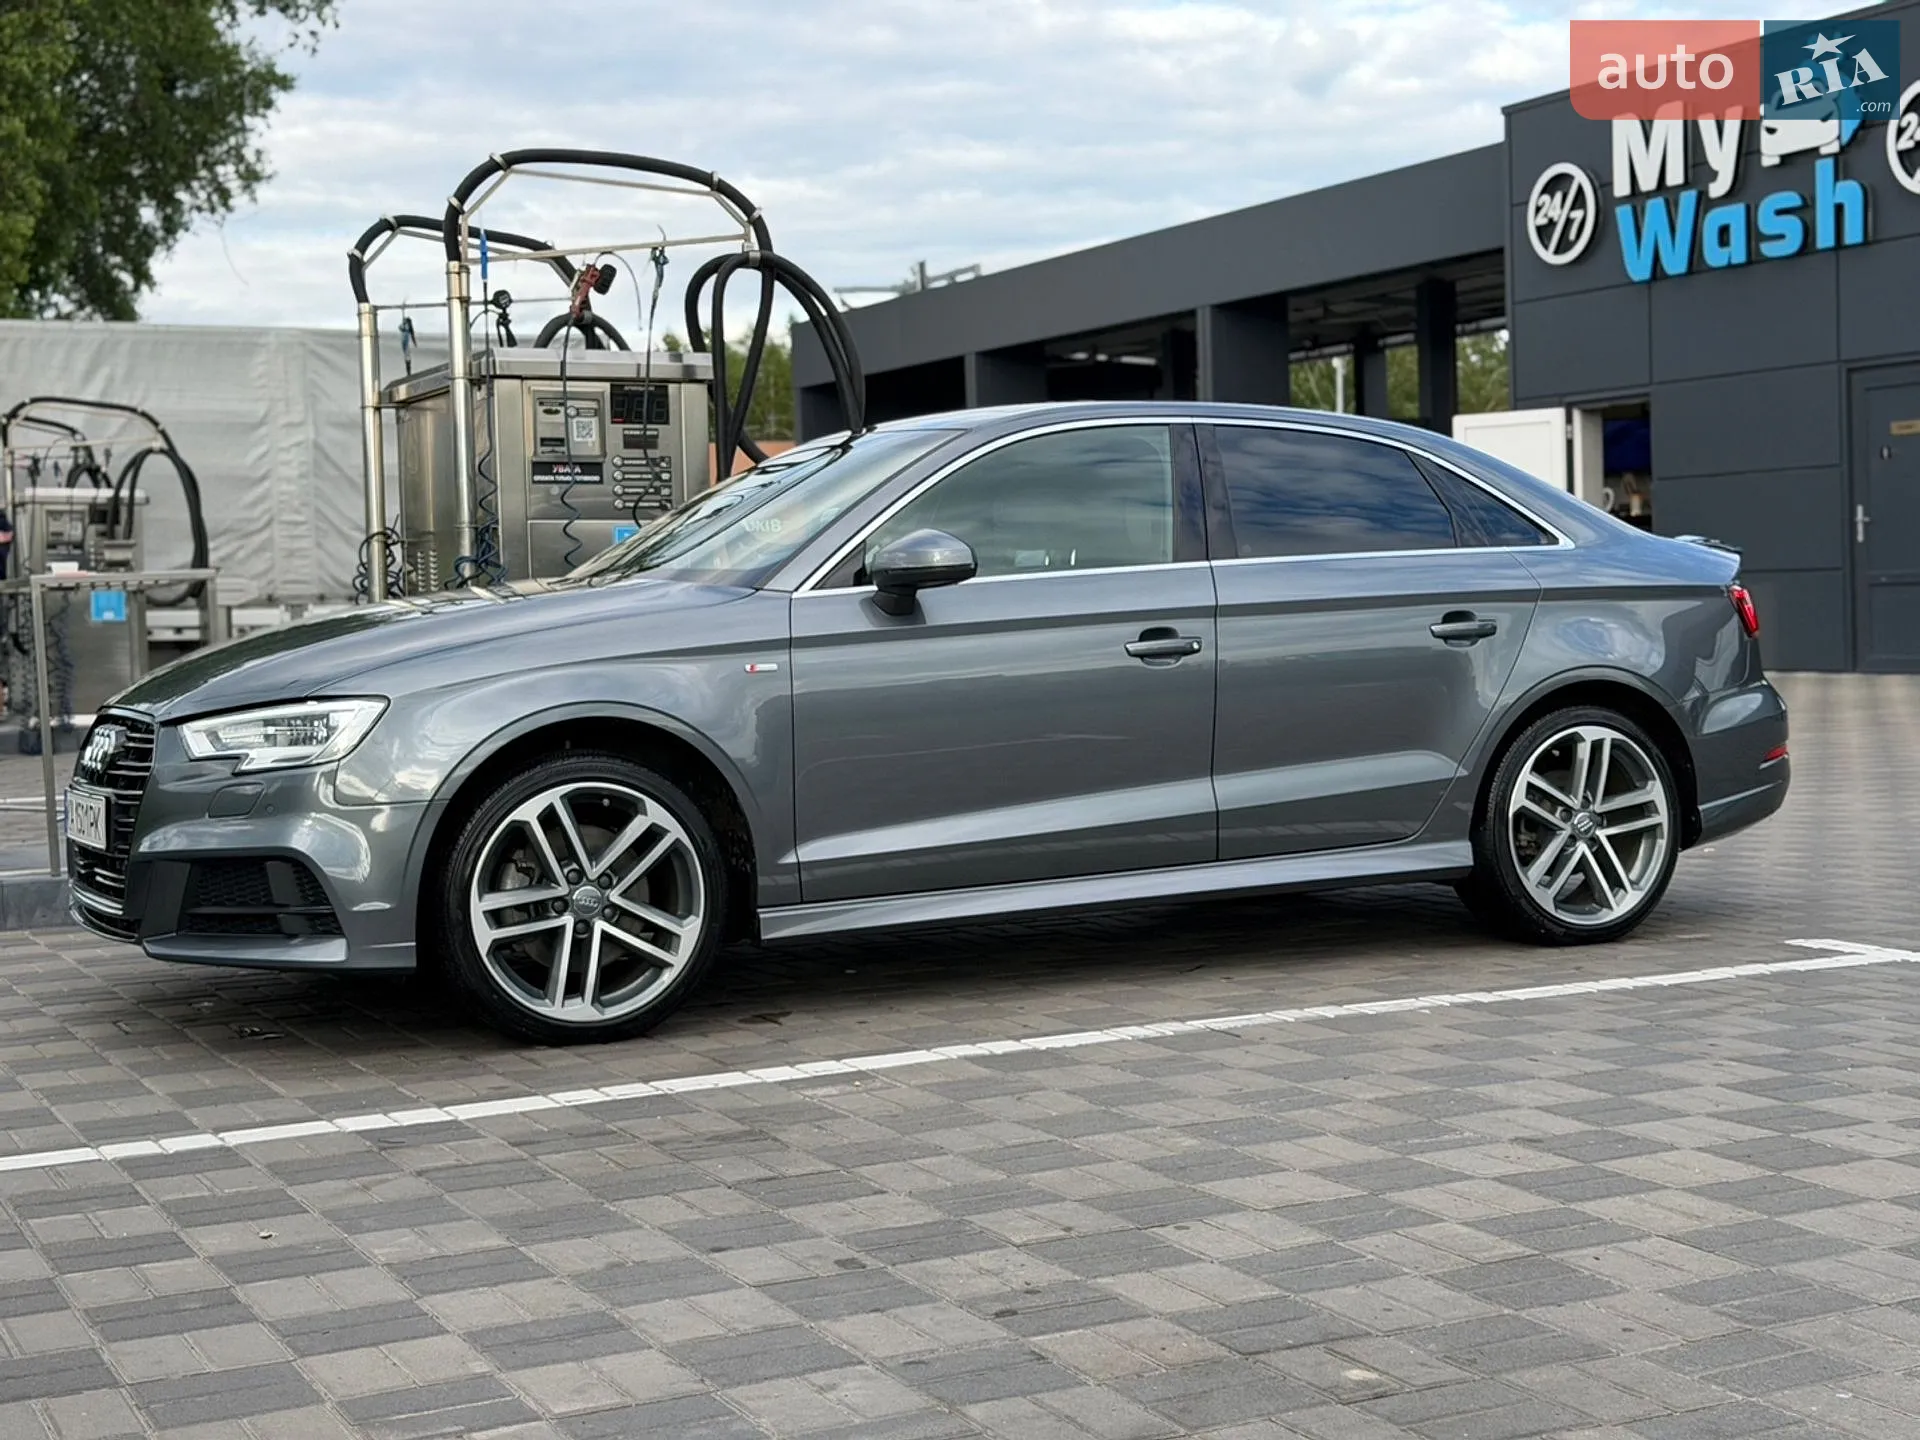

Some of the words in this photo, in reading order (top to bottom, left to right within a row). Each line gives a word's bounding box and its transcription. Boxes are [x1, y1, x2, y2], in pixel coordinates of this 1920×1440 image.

[1612, 100, 1744, 199] My
[1534, 178, 1586, 254] 24/7
[1614, 155, 1866, 283] Wash
